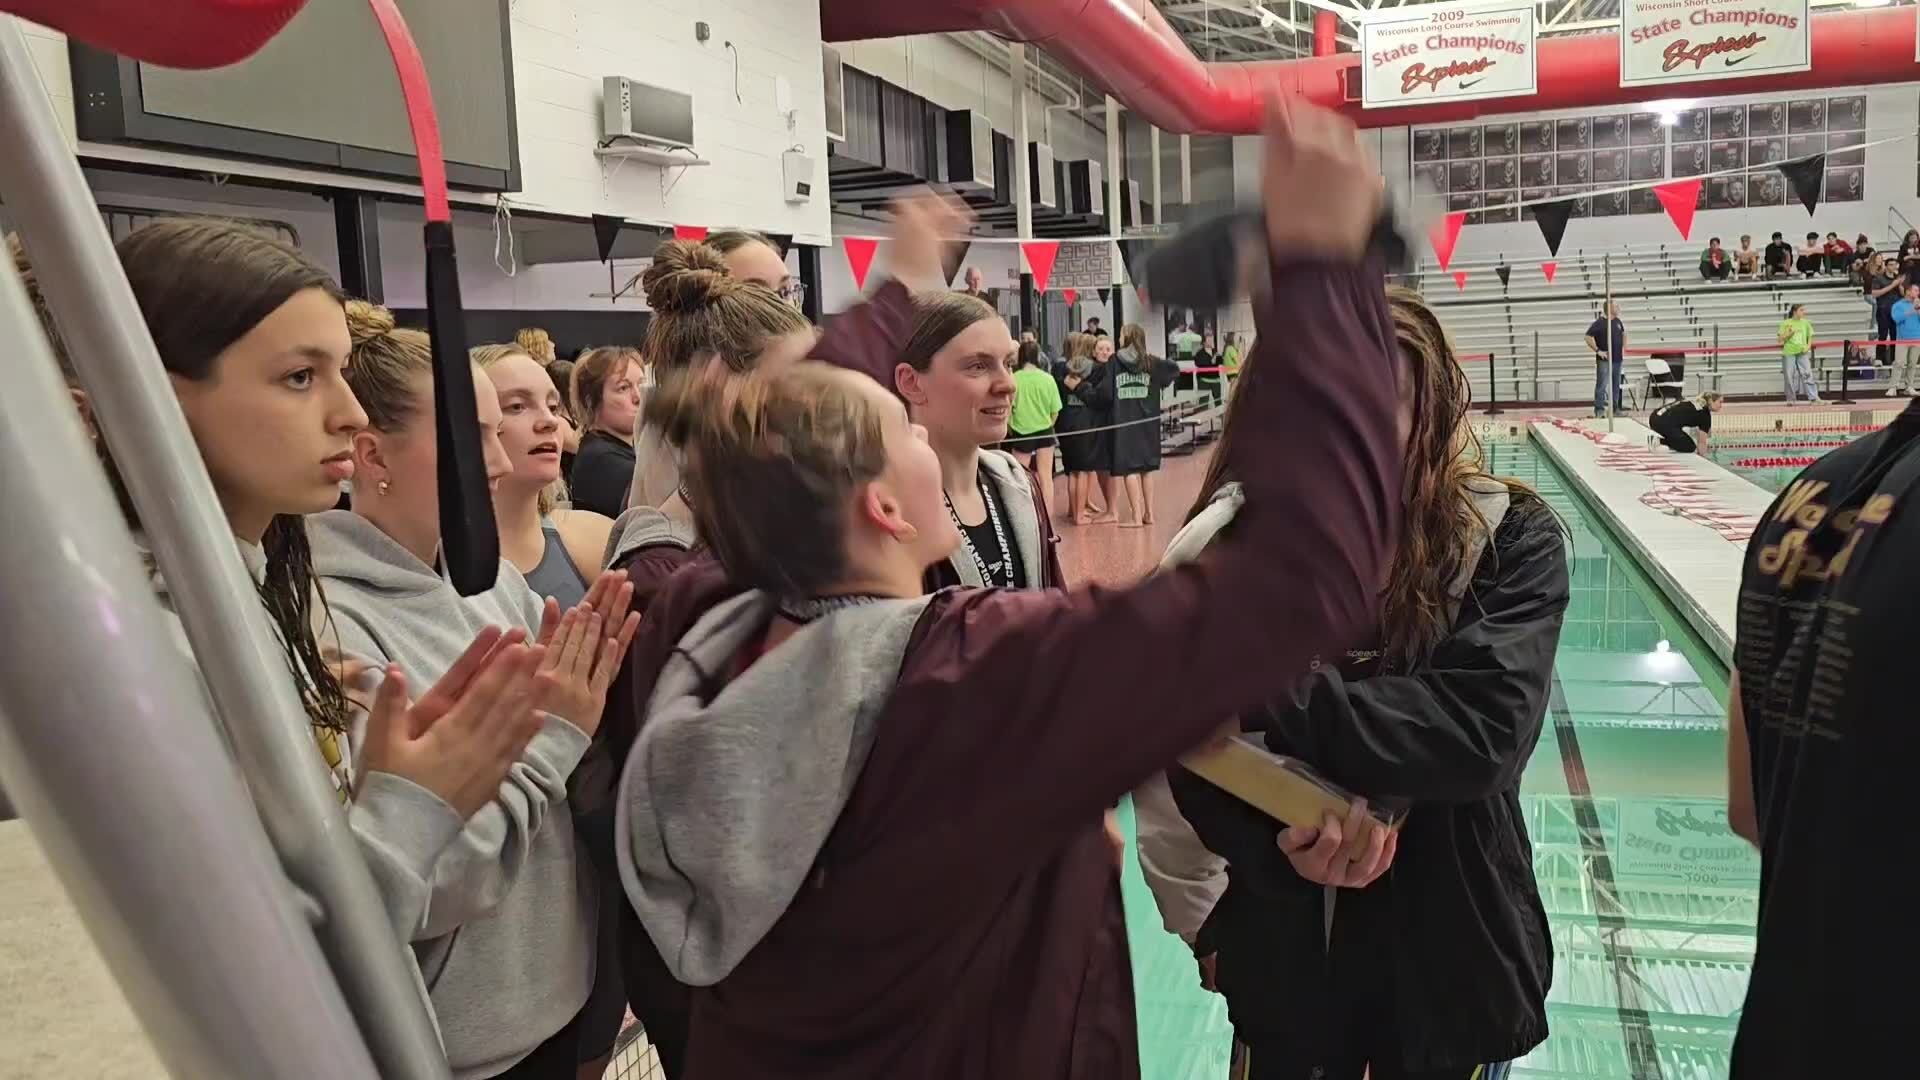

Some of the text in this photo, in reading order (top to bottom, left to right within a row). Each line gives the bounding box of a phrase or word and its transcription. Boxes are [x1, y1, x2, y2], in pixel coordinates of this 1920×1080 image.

[1431, 10, 1464, 23] 2009
[1636, 2, 1681, 12] Wisconsin
[1377, 16, 1521, 36] Wisconsin Long Course Swimming
[1630, 7, 1799, 44] State Champions
[1372, 33, 1526, 67] State Champions
[1662, 31, 1767, 72] Express
[1401, 56, 1496, 94] Express
